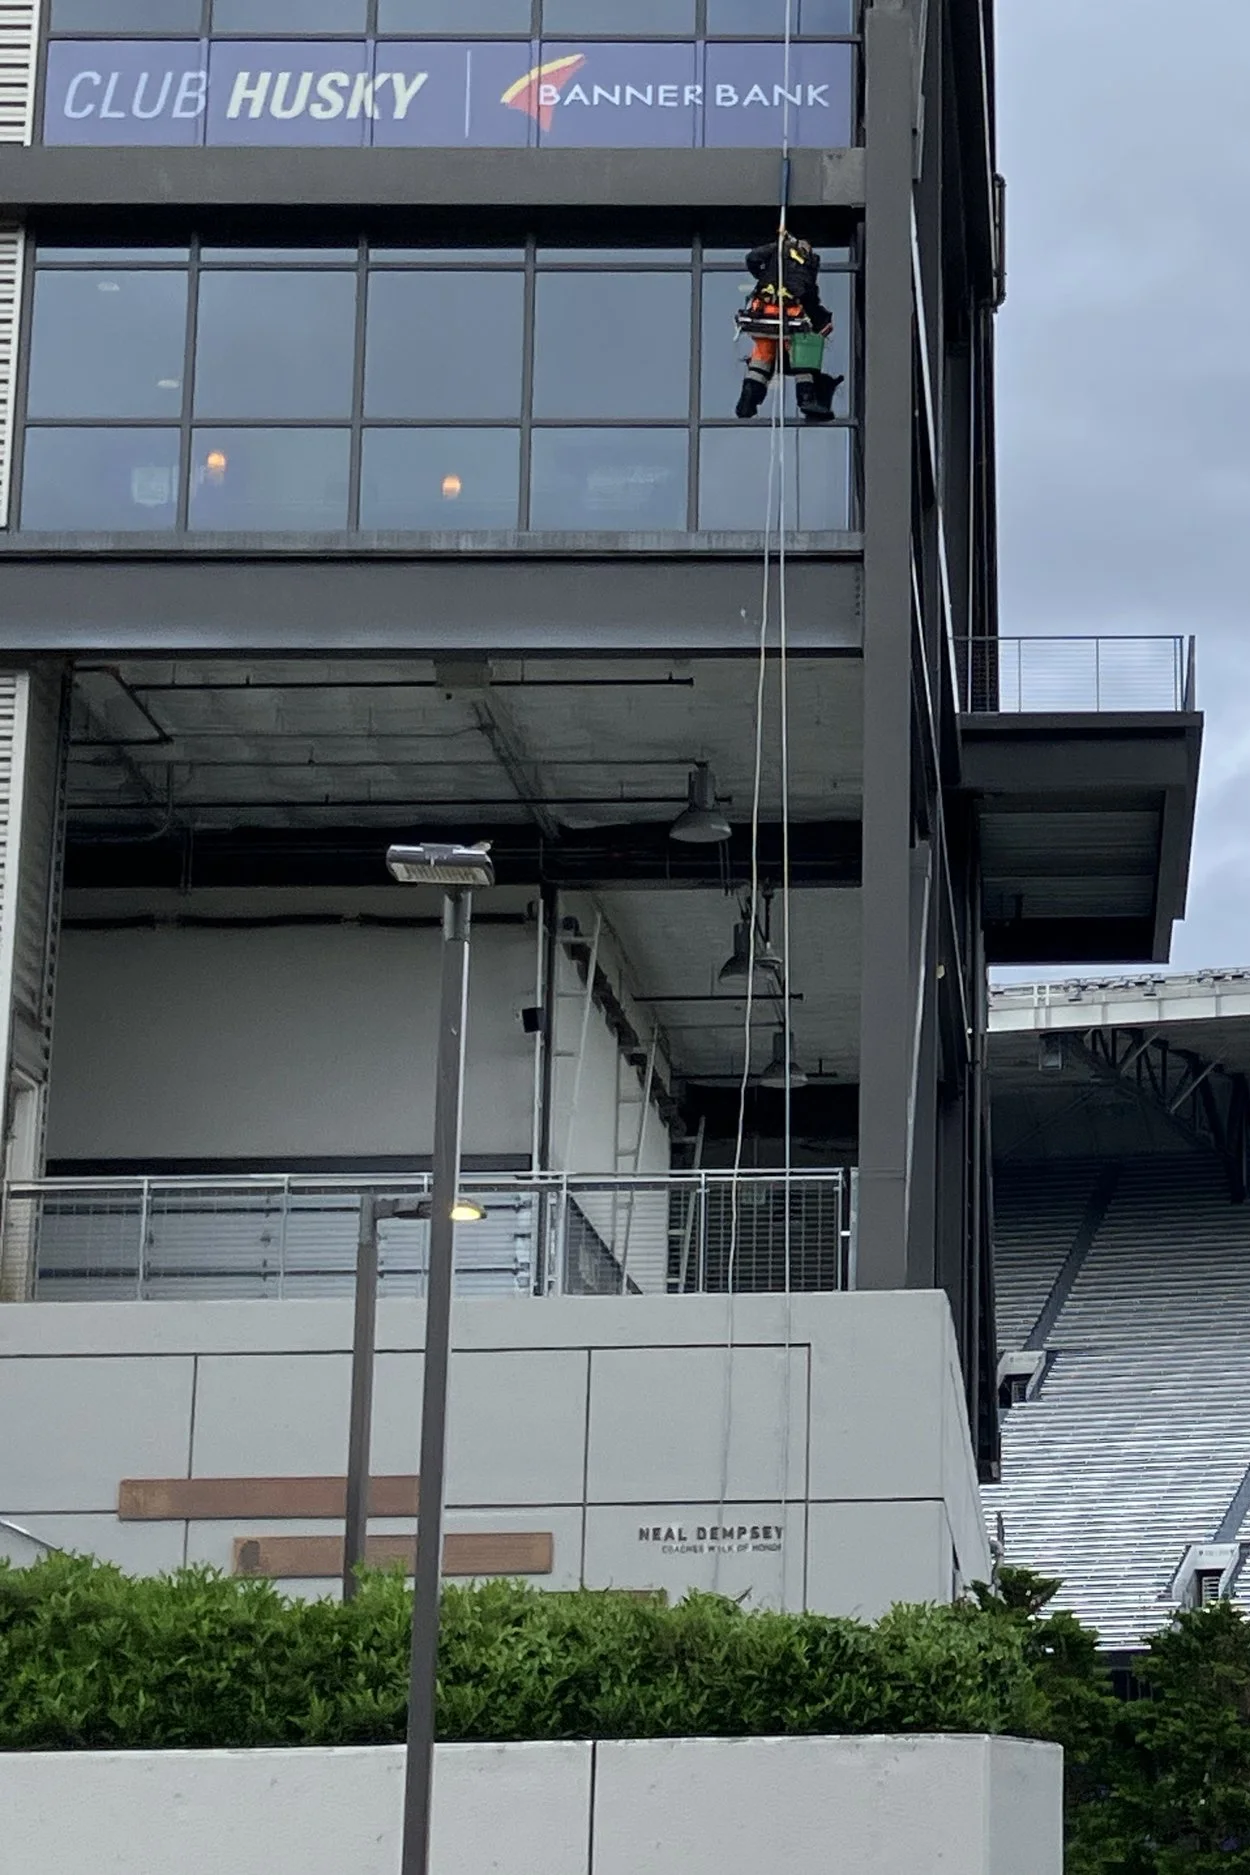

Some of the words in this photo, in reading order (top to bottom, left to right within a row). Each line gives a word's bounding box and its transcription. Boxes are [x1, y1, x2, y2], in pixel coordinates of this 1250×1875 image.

[63, 71, 208, 119] CLUB
[226, 71, 429, 120] HUSKY
[538, 84, 703, 106] BANNER
[715, 83, 830, 107] BANK
[639, 1527, 687, 1541] NEAL
[697, 1526, 783, 1540] DEMPSEY
